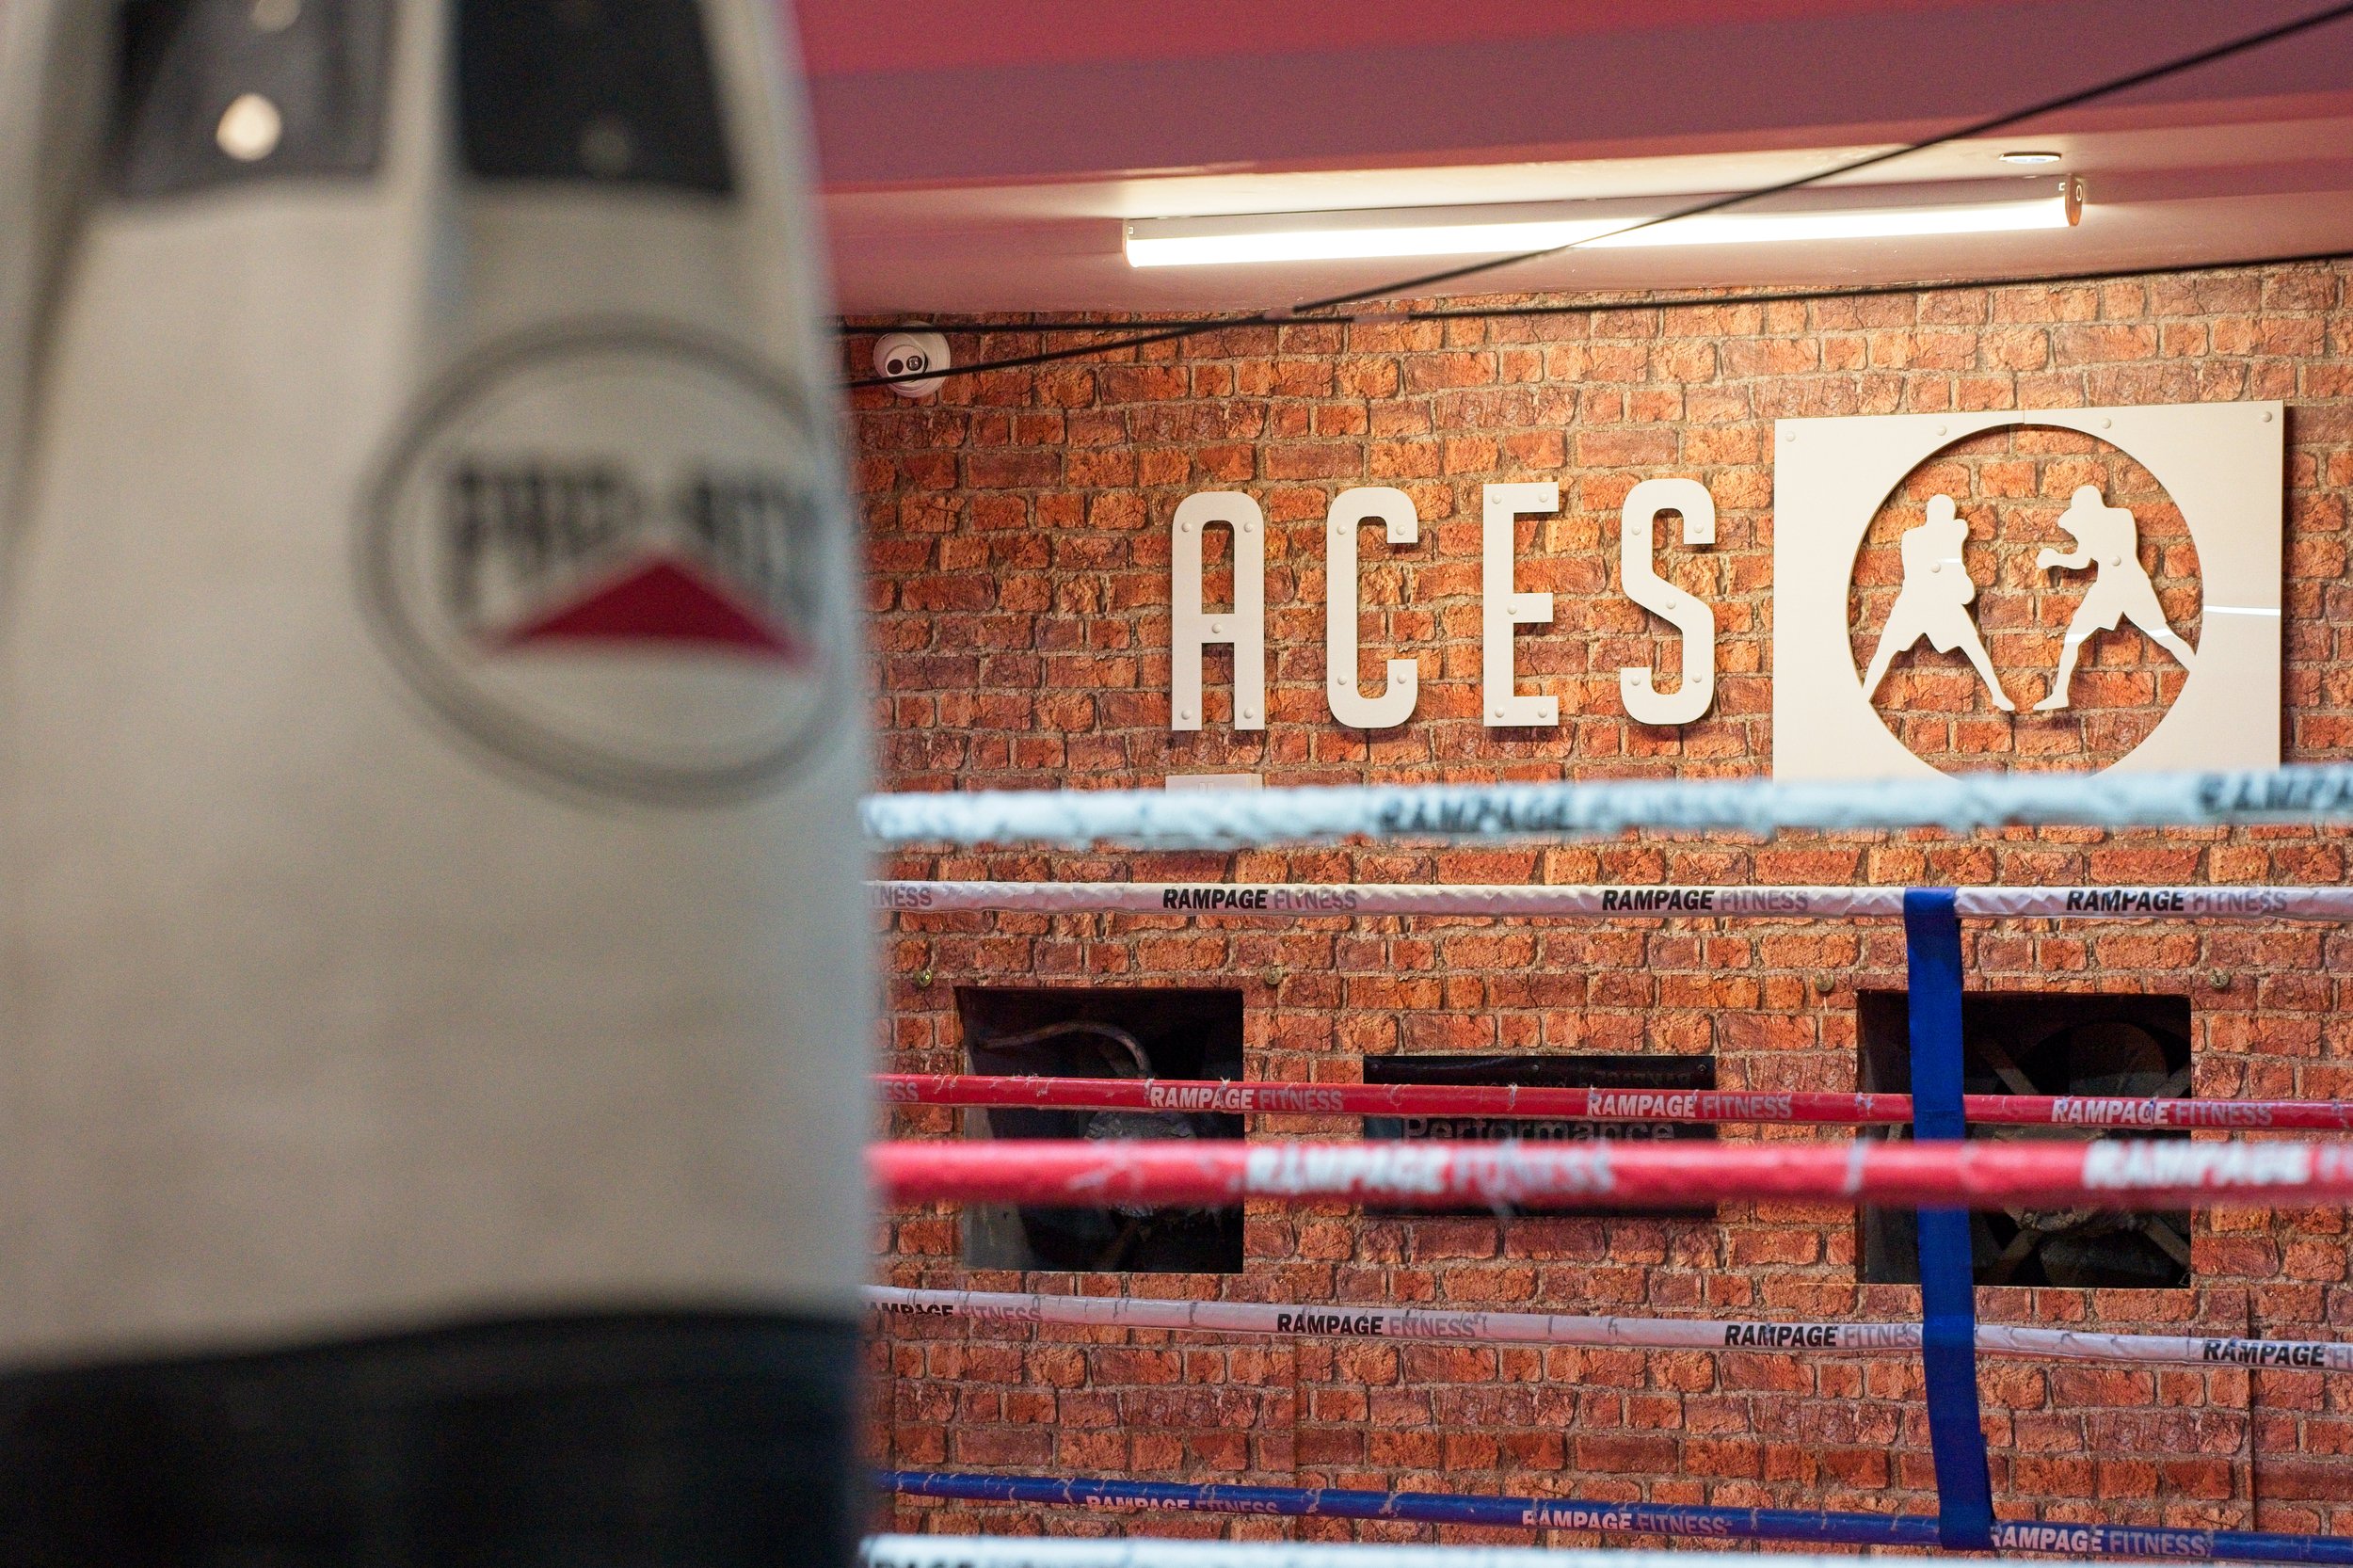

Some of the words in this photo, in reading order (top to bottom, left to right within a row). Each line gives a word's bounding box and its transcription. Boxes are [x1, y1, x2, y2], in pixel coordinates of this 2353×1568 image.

[1172, 478, 1715, 730] ACES
[1163, 888, 1267, 910] RAMPAGE
[1273, 889, 1356, 911] FITNESS
[1602, 888, 1712, 911] RAMPAGE
[1720, 889, 1809, 912] FITNESS
[2067, 889, 2184, 912] RAMPAGE
[2193, 890, 2288, 912] FITNESS
[1150, 1086, 1254, 1111] RAMPAGE
[1258, 1089, 1345, 1112] FITNESS
[1587, 1093, 1696, 1118] RAMPAGE
[1703, 1096, 1793, 1120] FITNESS
[2052, 1098, 2169, 1125] RAMPAGE
[2174, 1102, 2273, 1126] FITNESS
[1277, 1313, 1383, 1336] RAMPAGE
[1389, 1316, 1476, 1338] FITNESS
[1724, 1324, 1837, 1348] RAMPAGE
[2203, 1338, 2326, 1368] RAMPAGE
[1522, 1510, 1633, 1531] RAMPAGE
[1638, 1512, 1727, 1536] FITNESS
[2108, 1530, 2206, 1558] FITNESS
